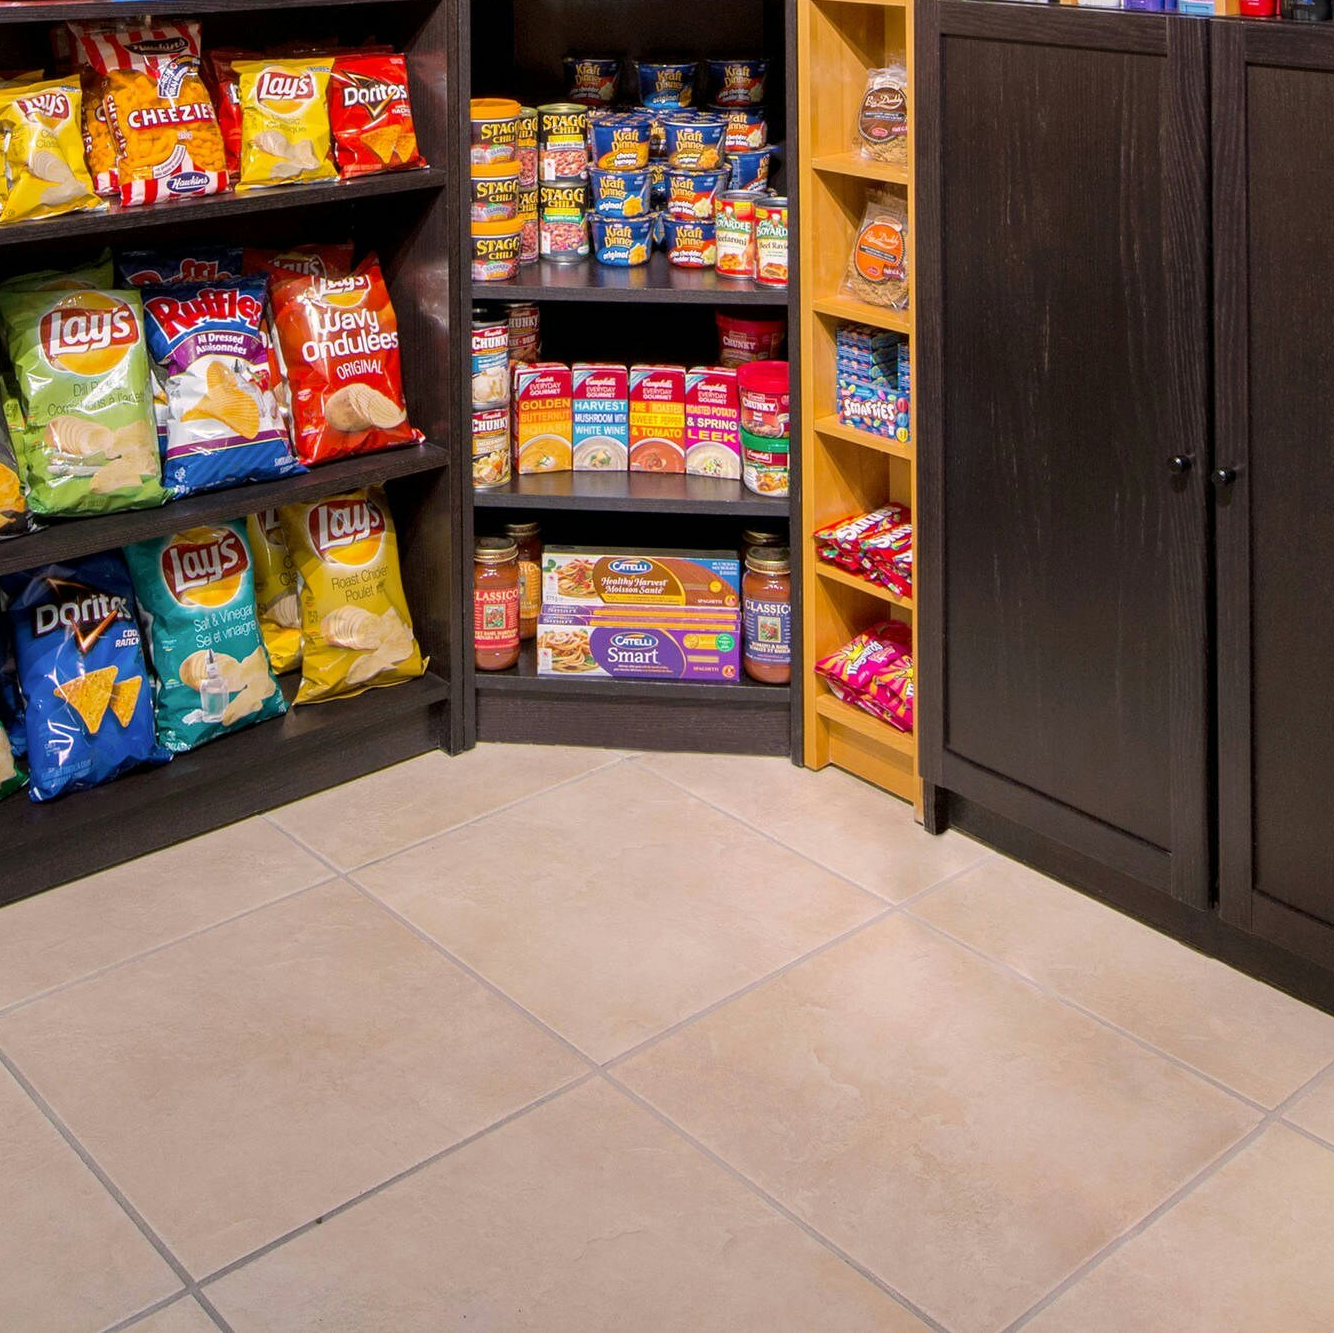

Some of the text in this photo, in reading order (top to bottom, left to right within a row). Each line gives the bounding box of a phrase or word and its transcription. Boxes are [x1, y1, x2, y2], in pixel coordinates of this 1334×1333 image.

[543, 115, 586, 128] STAGG
[552, 126, 580, 134] CHILI
[613, 130, 639, 142] Kraft
[612, 142, 640, 152] Dinner
[171, 175, 209, 189] Hawkins
[49, 308, 131, 356] Lay's
[336, 360, 383, 381] ORIGINAL
[521, 399, 570, 411] GOLDEN
[575, 401, 626, 411] HARVEST
[844, 398, 895, 420] SMARTIES
[687, 430, 736, 441] LEEK
[602, 576, 667, 587] Healthy Harvest
[193, 619, 209, 632] Salt
[211, 615, 218, 626] &
[614, 635, 654, 647] CATELLI
[608, 647, 658, 664] Smart
